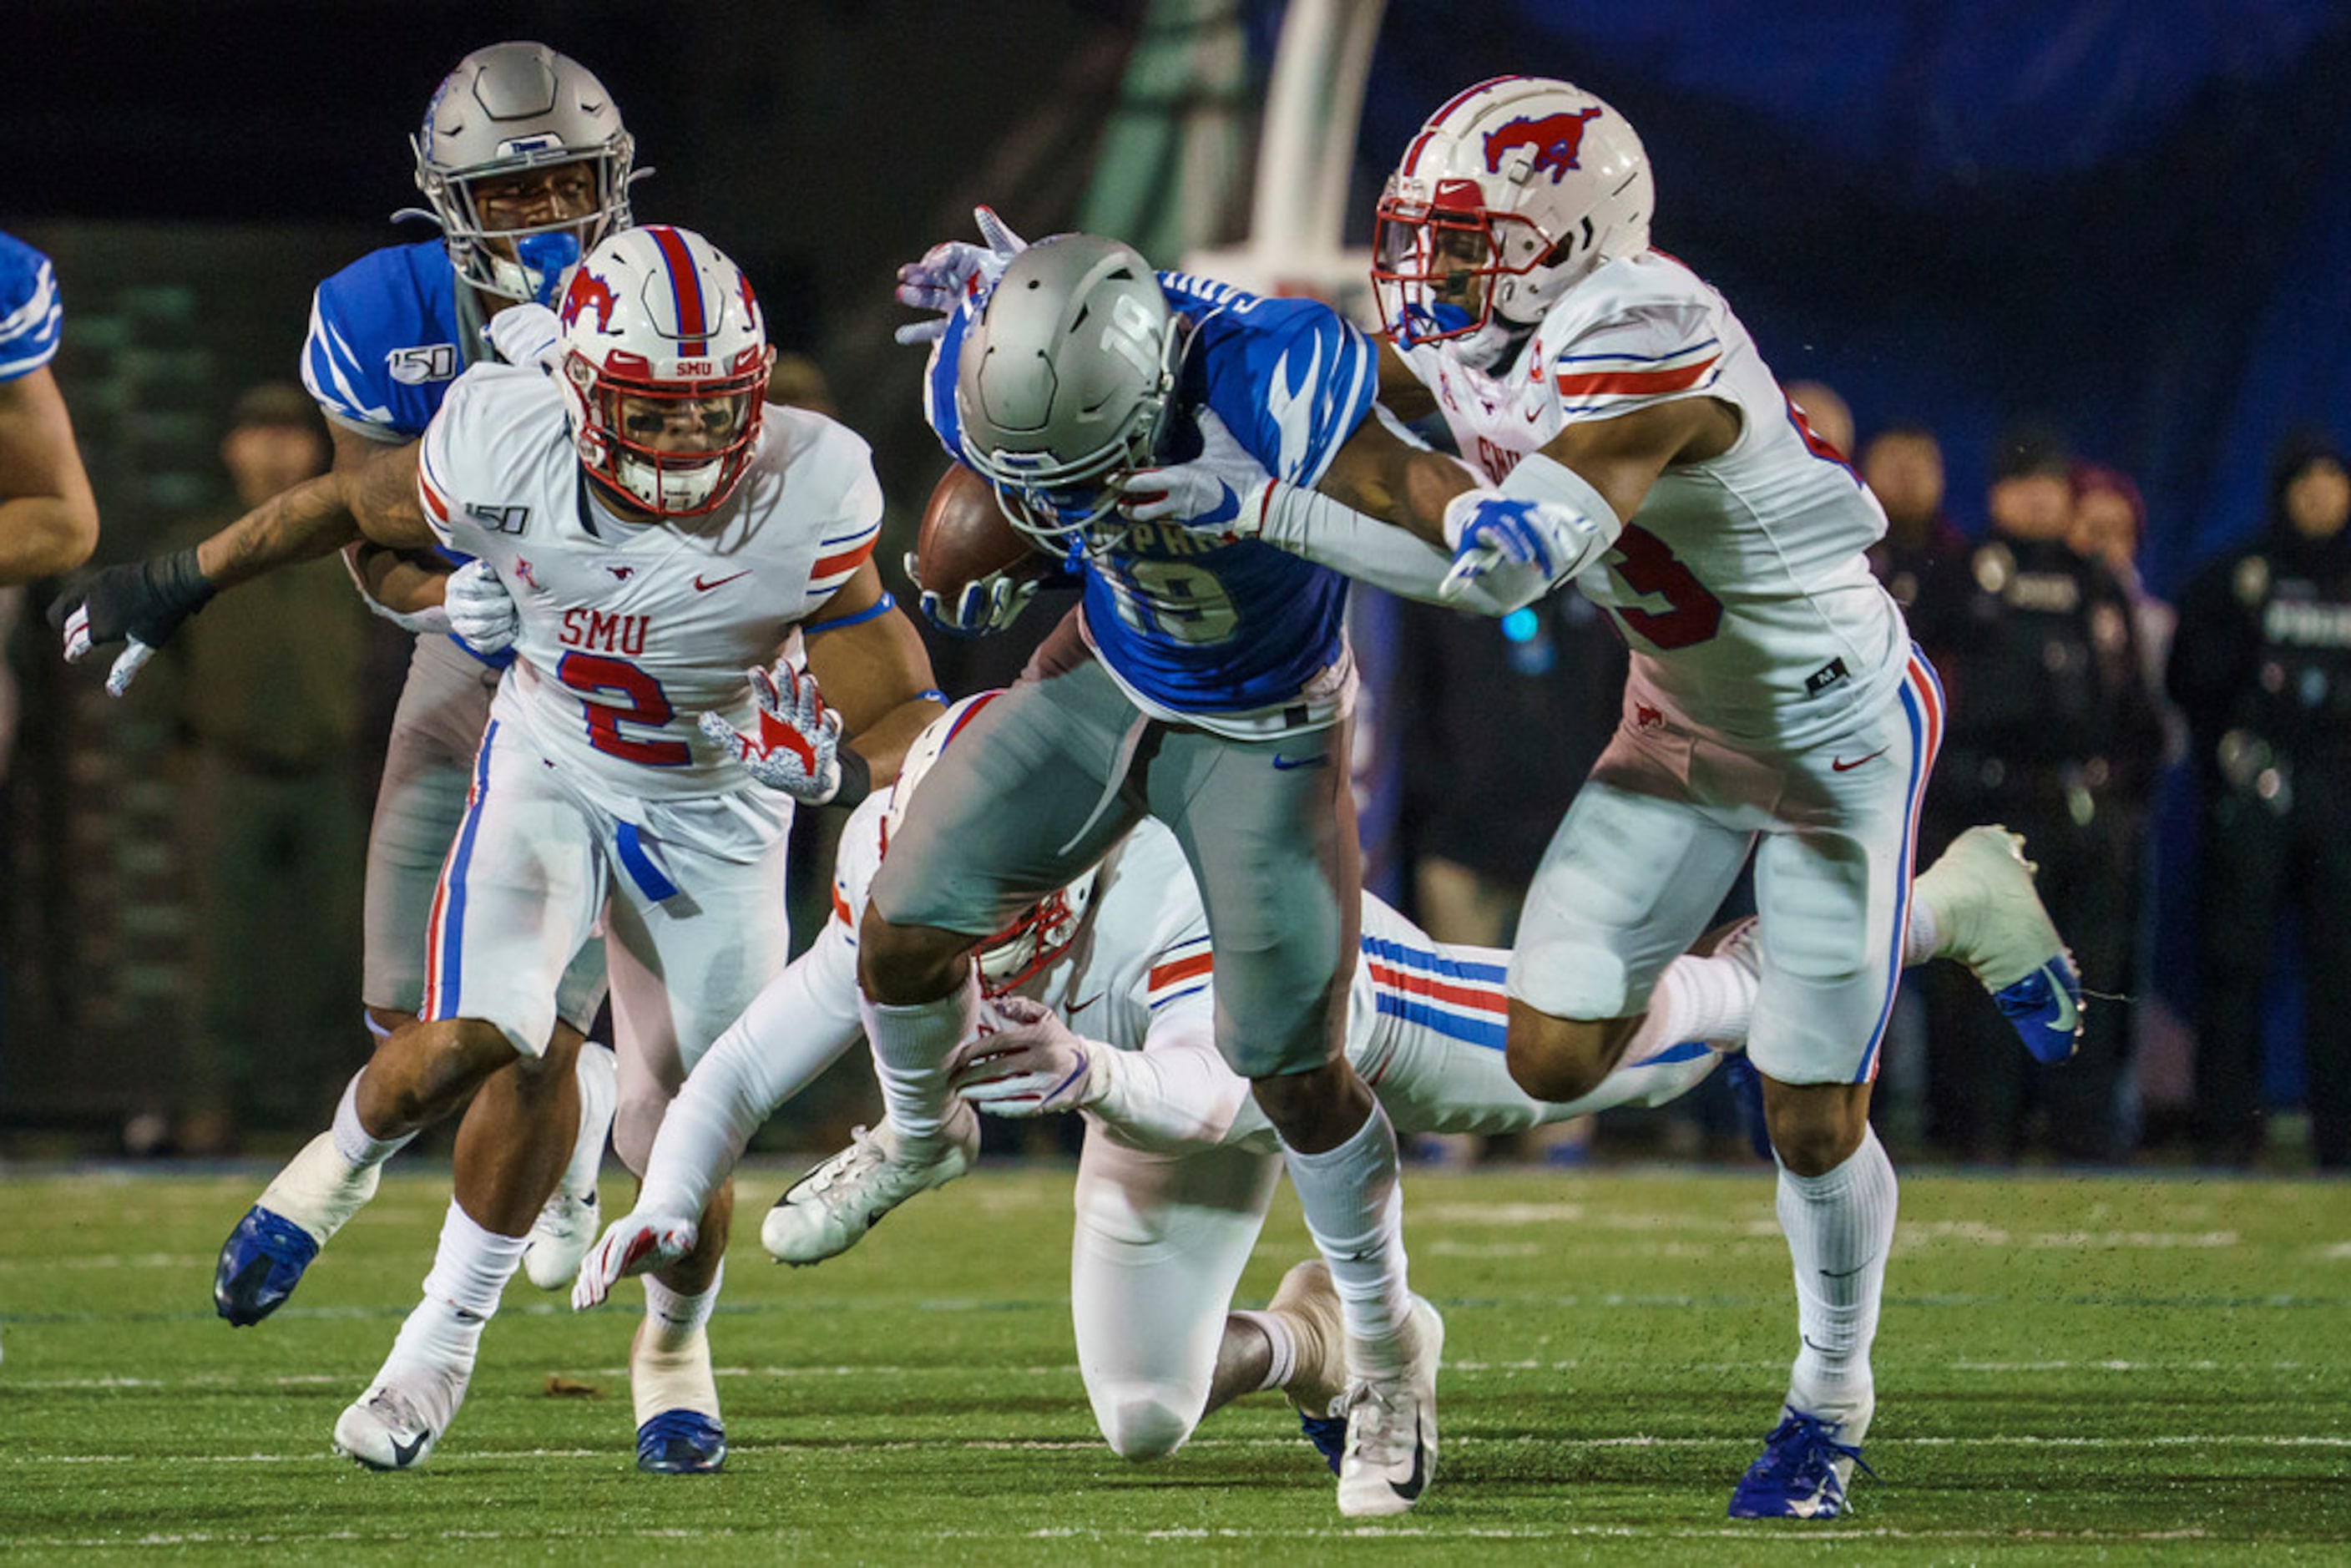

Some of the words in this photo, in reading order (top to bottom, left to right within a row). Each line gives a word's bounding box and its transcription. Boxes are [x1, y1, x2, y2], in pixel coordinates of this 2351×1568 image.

[1100, 294, 1160, 377] 19
[387, 344, 456, 384] 150
[676, 362, 712, 377] SMU
[465, 502, 530, 535] 150
[1612, 521, 1725, 650] 3
[559, 608, 650, 655] SMU
[556, 650, 692, 766] 2
